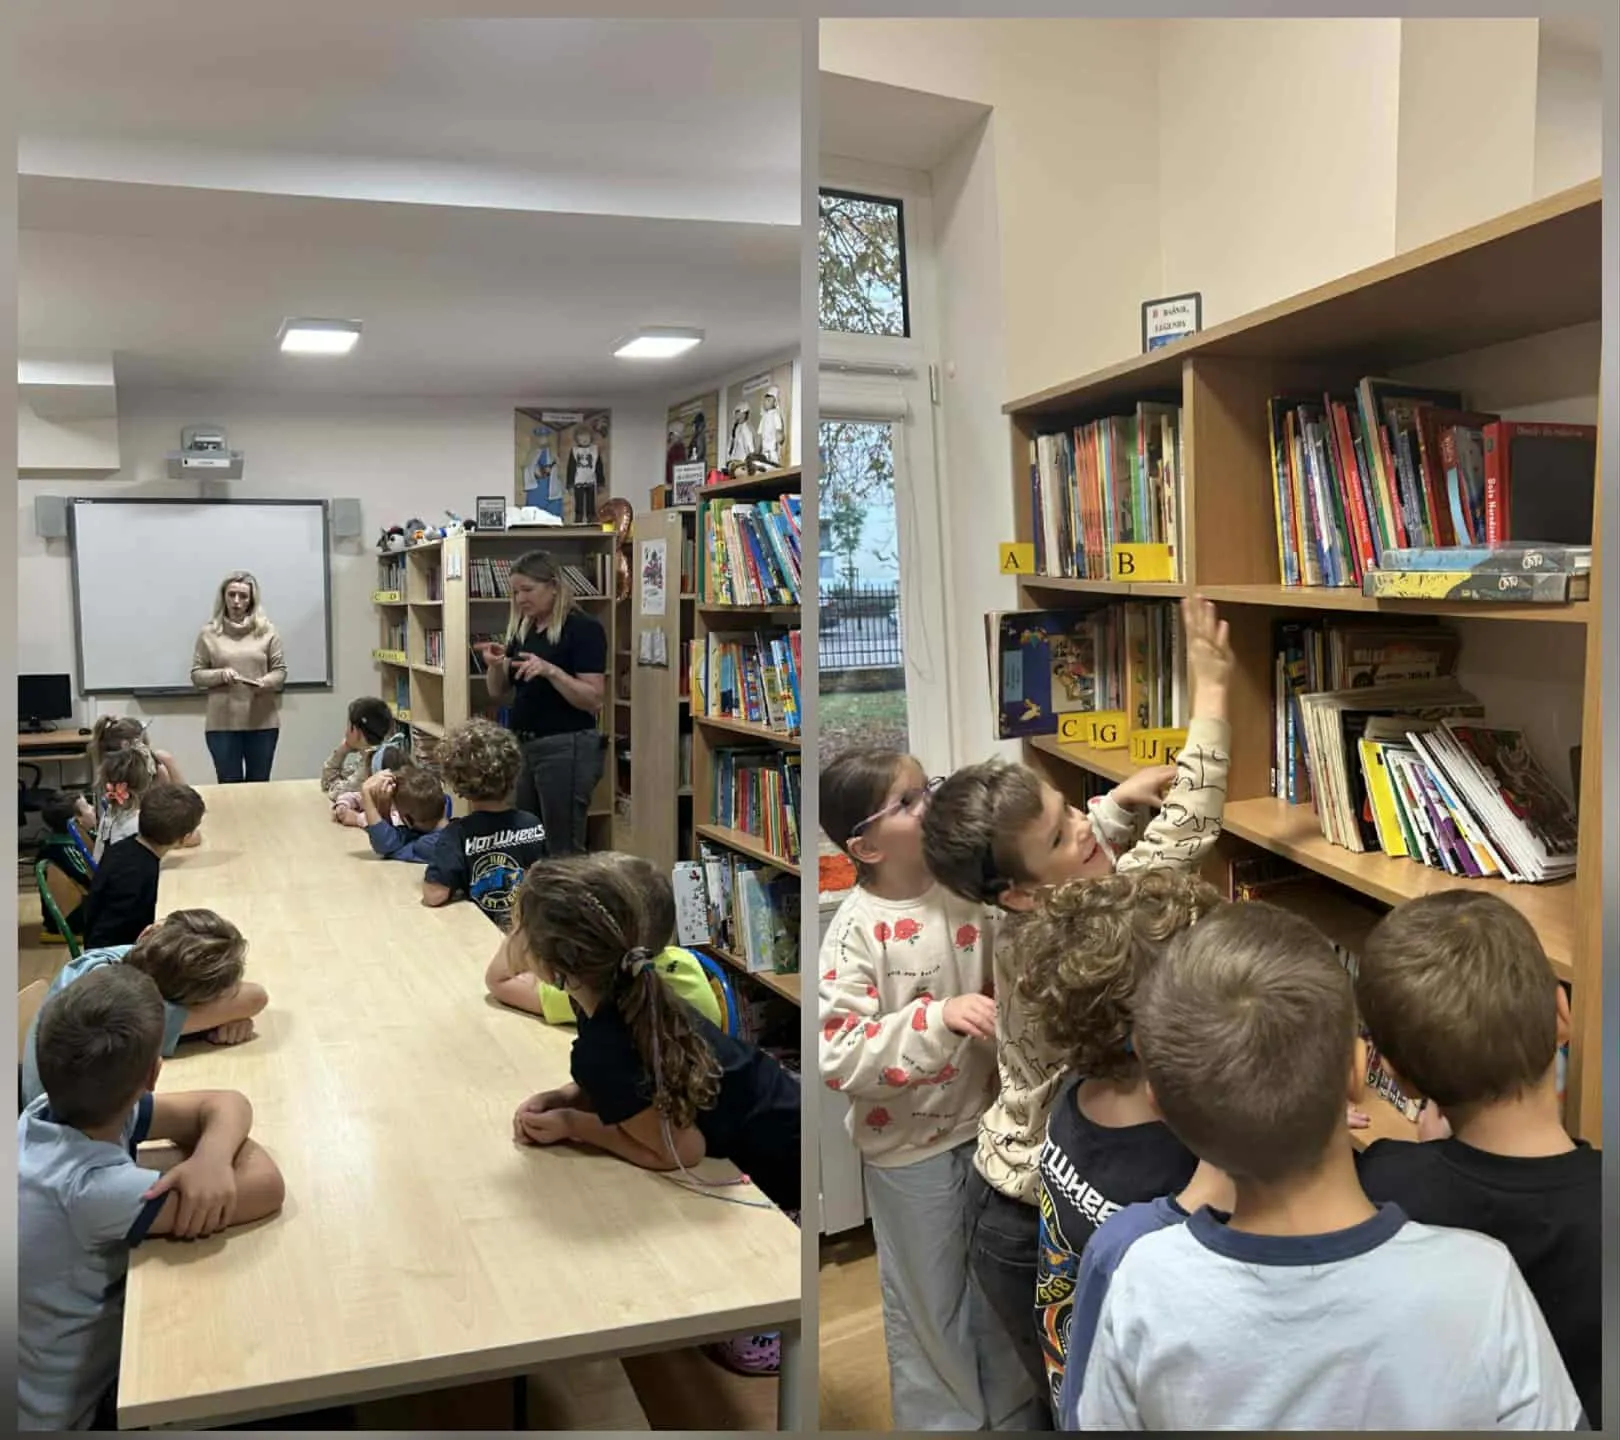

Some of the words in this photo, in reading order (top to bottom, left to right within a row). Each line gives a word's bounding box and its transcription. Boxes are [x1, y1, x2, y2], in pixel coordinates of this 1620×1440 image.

[1004, 552, 1020, 569] A
[1117, 552, 1135, 575] B
[1062, 720, 1078, 737] C
